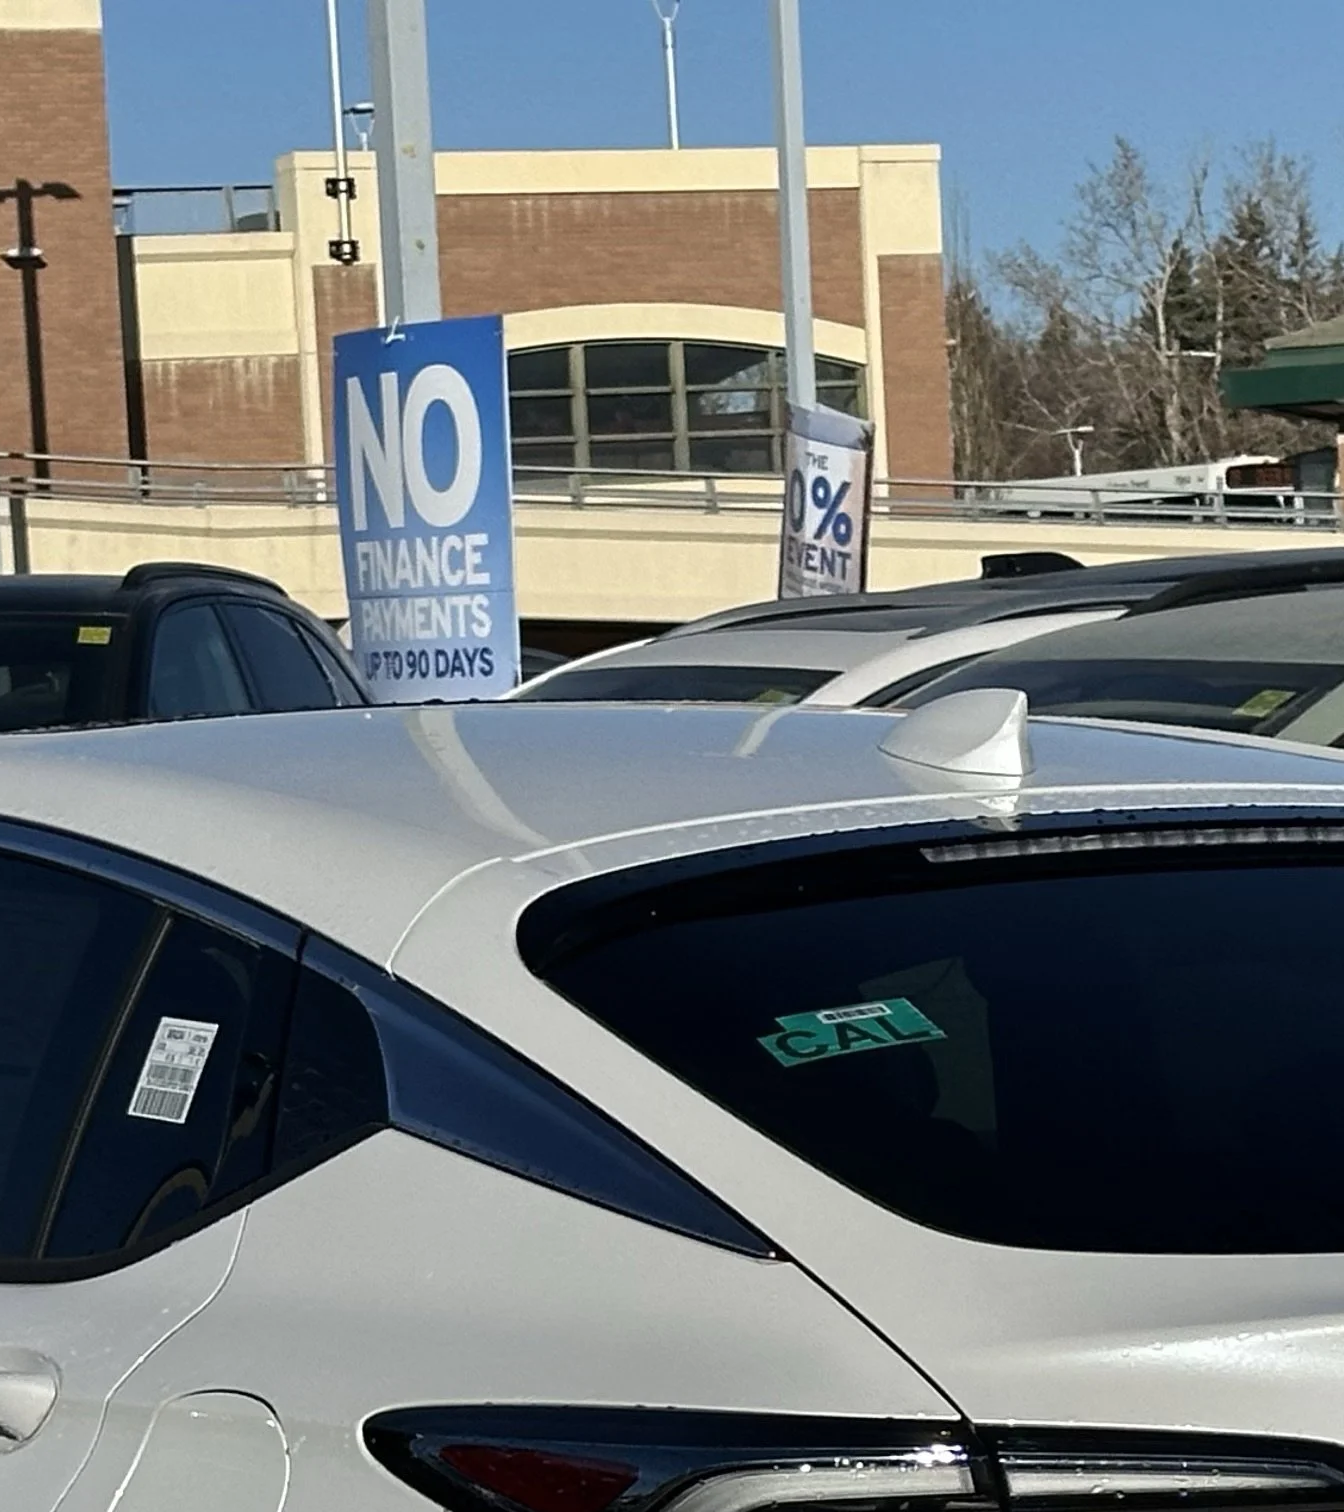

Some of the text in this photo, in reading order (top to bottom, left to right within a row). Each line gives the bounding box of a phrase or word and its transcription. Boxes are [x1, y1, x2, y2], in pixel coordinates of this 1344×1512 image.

[346, 363, 482, 531] NO
[805, 451, 829, 471] THE
[789, 468, 853, 546] 0%
[357, 533, 492, 592] FINANCE
[787, 535, 852, 581] EVENT
[361, 594, 493, 642] PAYMENTS
[365, 647, 495, 681] UP TO 90 DAYS
[775, 1016, 934, 1059] CAL
